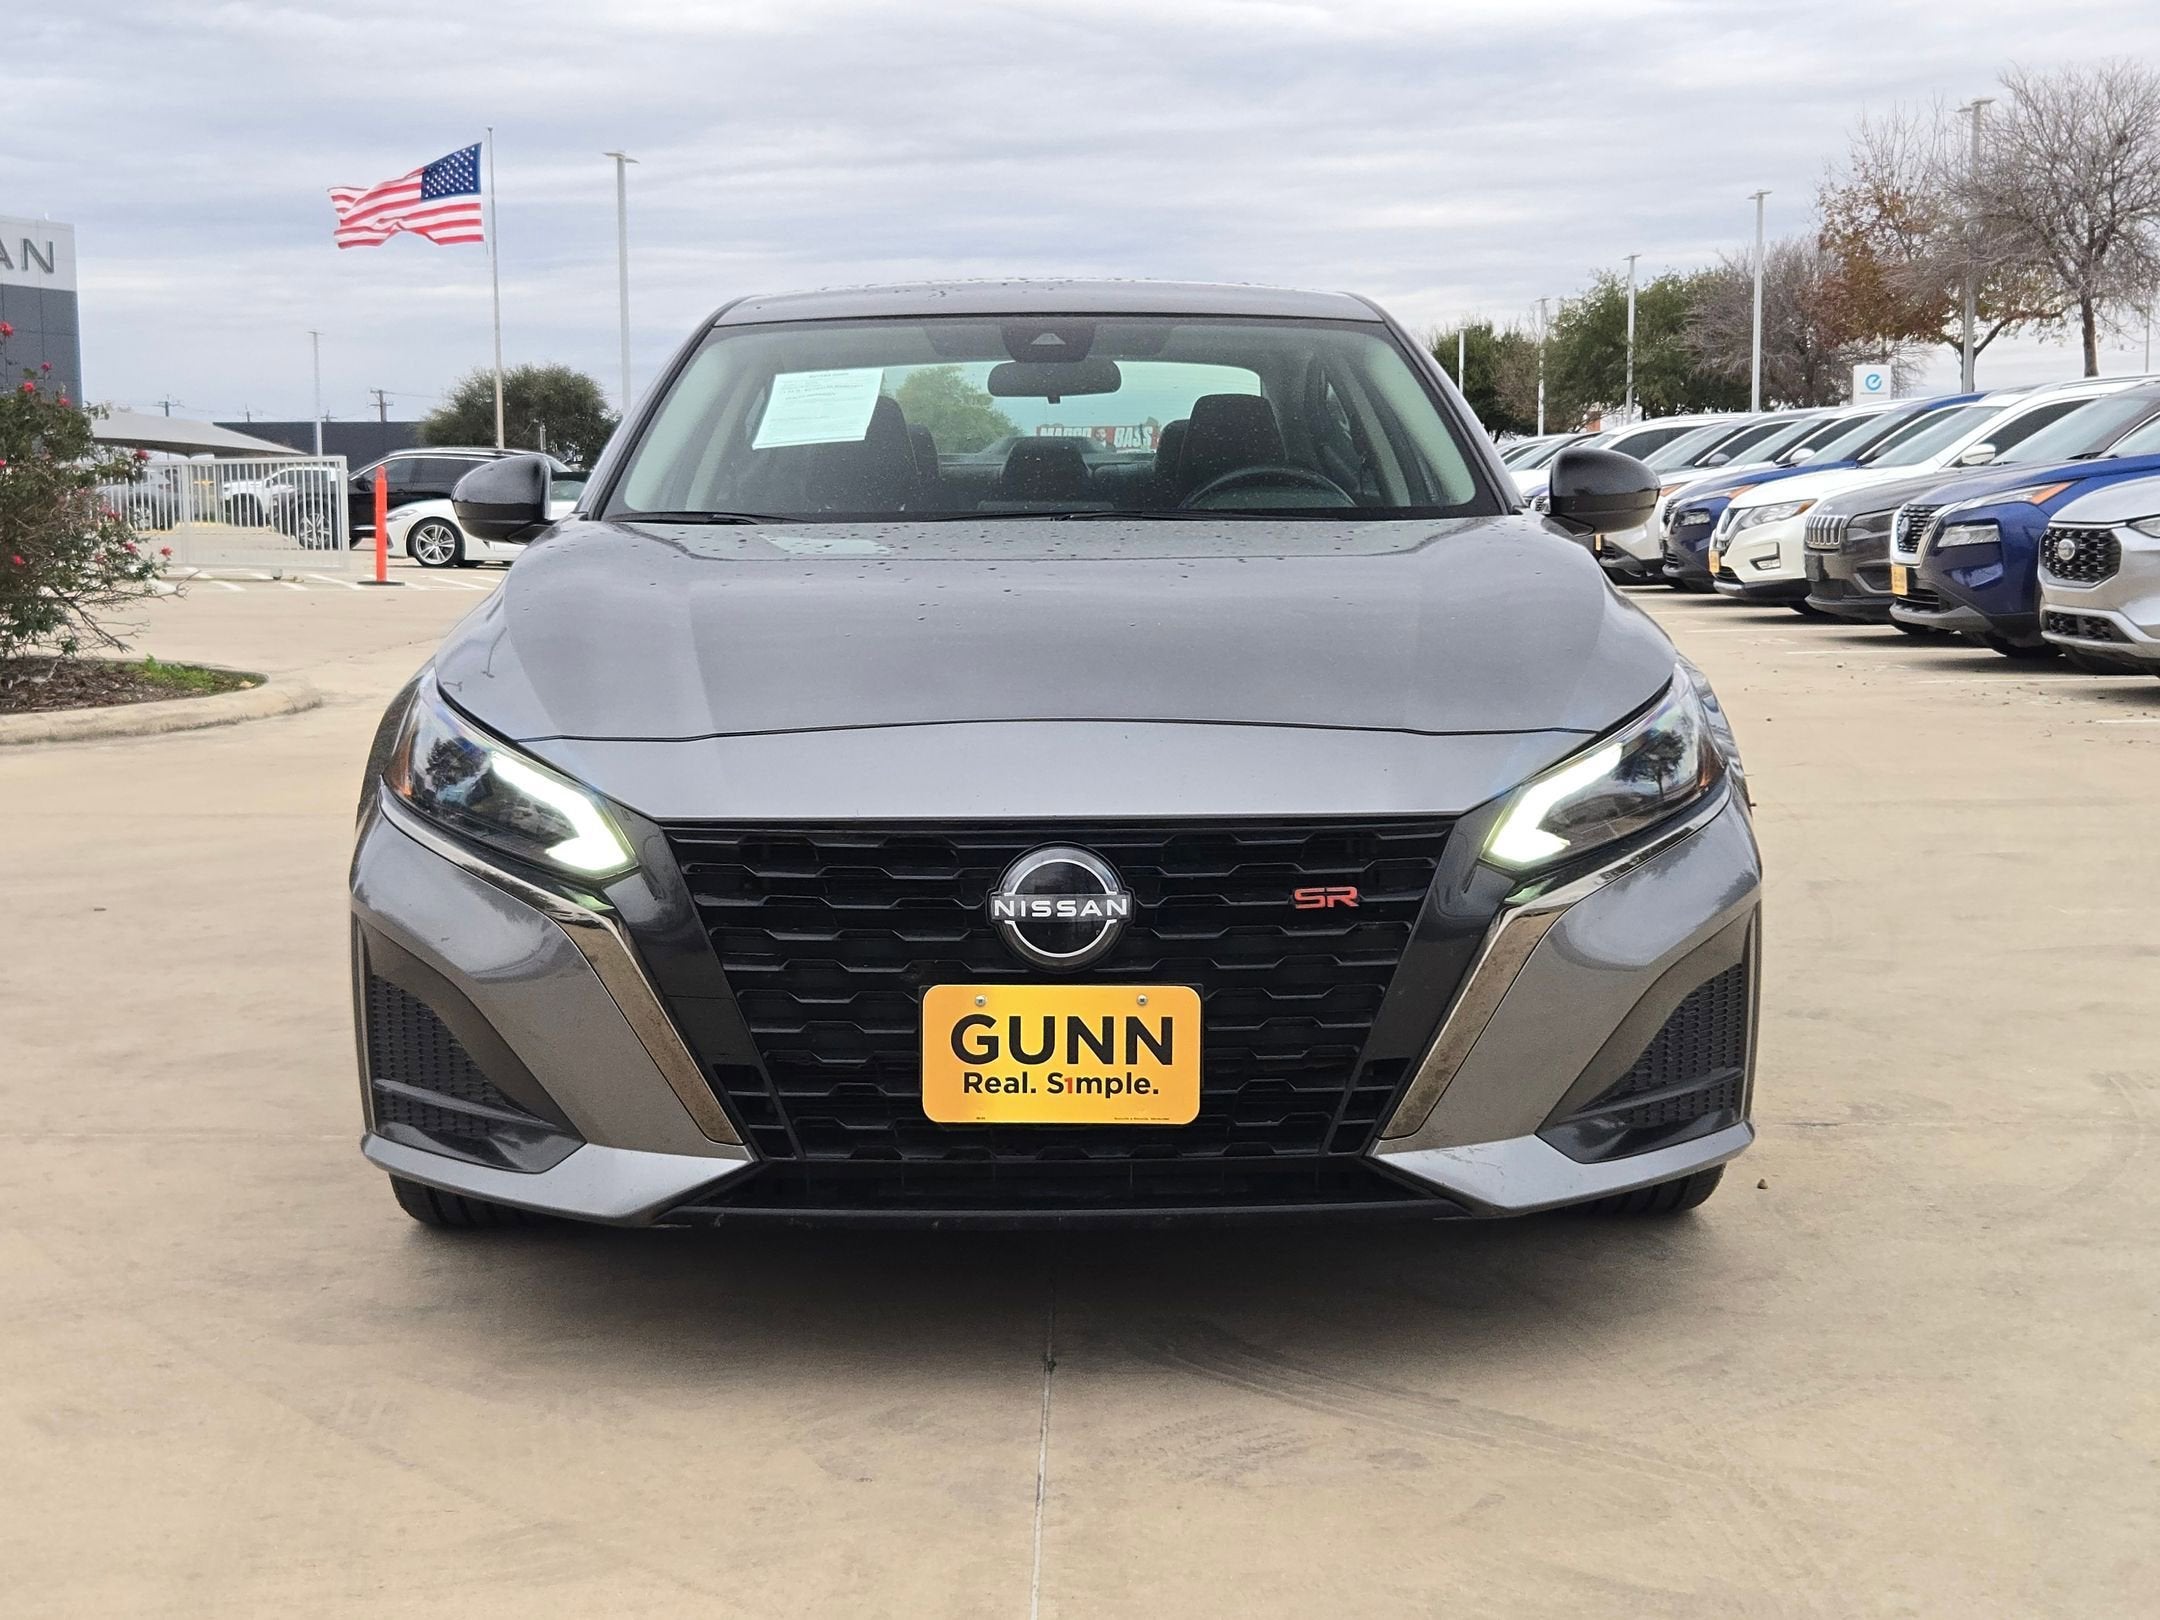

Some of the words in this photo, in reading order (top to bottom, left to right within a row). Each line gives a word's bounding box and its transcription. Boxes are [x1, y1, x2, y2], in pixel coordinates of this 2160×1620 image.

[1114, 427, 1153, 448] BASS
[994, 899, 1127, 917] NISSAN
[1294, 886, 1359, 909] SR
[951, 1014, 1173, 1065] GUNN
[963, 1071, 1037, 1094] Real.
[1046, 1072, 1159, 1098] S1mple.
